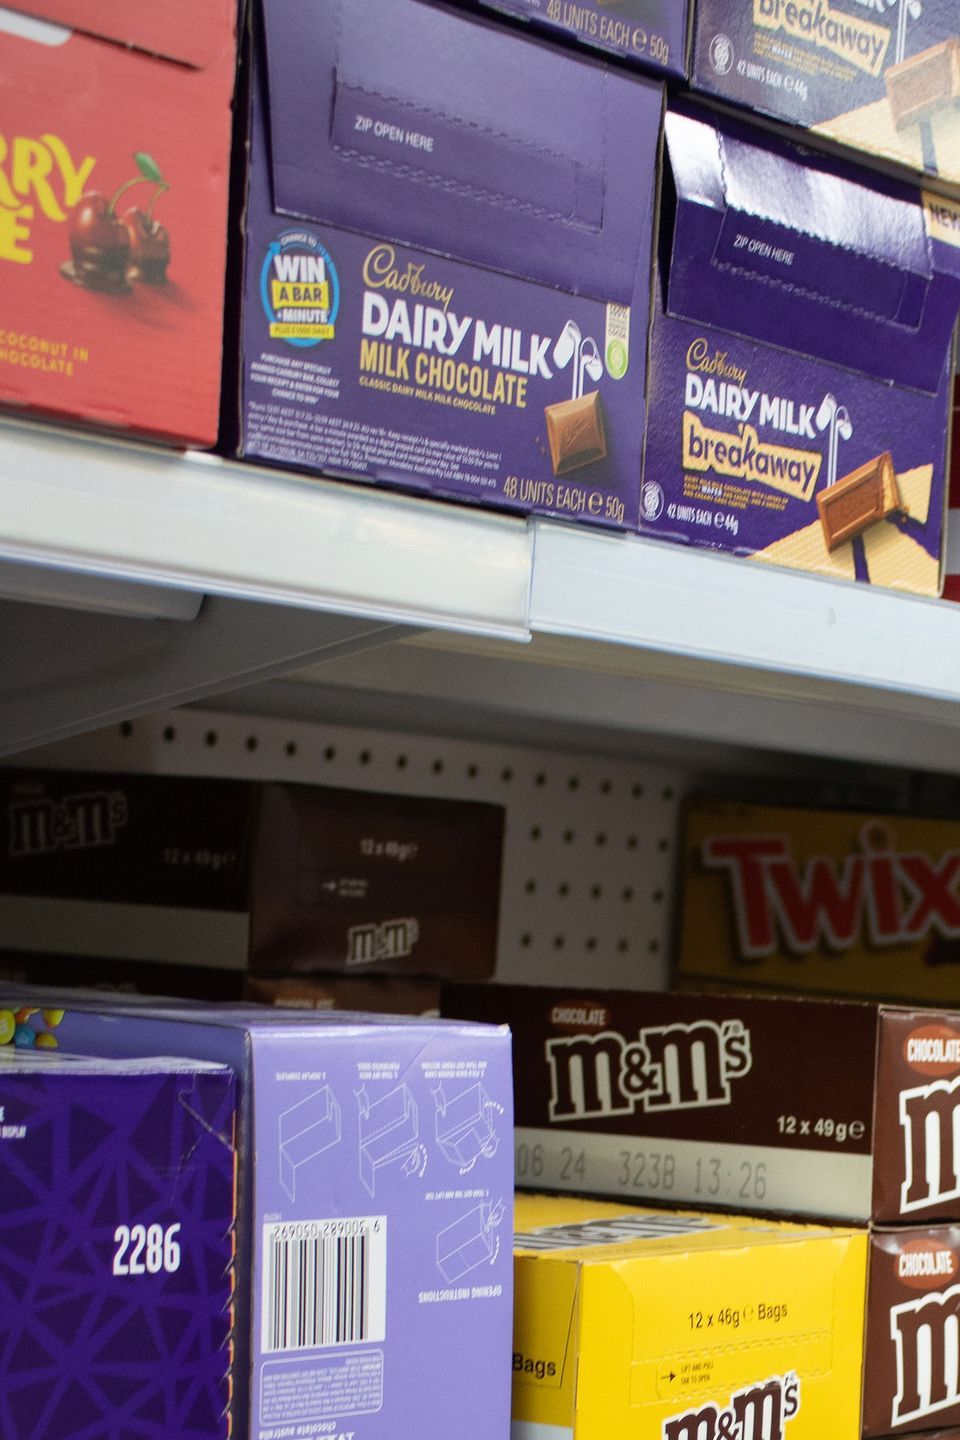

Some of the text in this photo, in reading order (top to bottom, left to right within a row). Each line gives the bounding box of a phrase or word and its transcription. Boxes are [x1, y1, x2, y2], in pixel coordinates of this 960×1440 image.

[547, 4, 670, 66] 48 UNITS EACH 50g
[355, 115, 434, 152] ZIP OPEN HERE
[733, 233, 796, 266] ZIP OPEN HERE
[273, 255, 326, 284] WIN
[363, 243, 455, 312] Cadbury
[279, 286, 323, 302] A BAR
[281, 308, 328, 324] MINUTE
[362, 290, 473, 356] DAIRY
[473, 319, 554, 380] MILK
[359, 338, 529, 409] MILK CHOCOLATE
[685, 337, 747, 388] Cadbury
[684, 372, 817, 440] DAIRY MILK
[688, 423, 817, 494] breakaway
[503, 476, 626, 525] 48 UNITS EACH 50g
[676, 504, 697, 524] UNITS
[696, 508, 713, 526] EACH
[550, 1006, 607, 1027] CHOCOLATE
[777, 1115, 796, 1135] 12
[559, 1146, 586, 1181] 24
[112, 1222, 181, 1276] 2286
[898, 1248, 954, 1278] CHOCOLATE
[687, 1302, 789, 1330] 12 46g Bags
[512, 1353, 557, 1377] Bags
[296, 1420, 337, 1438] chocolate
